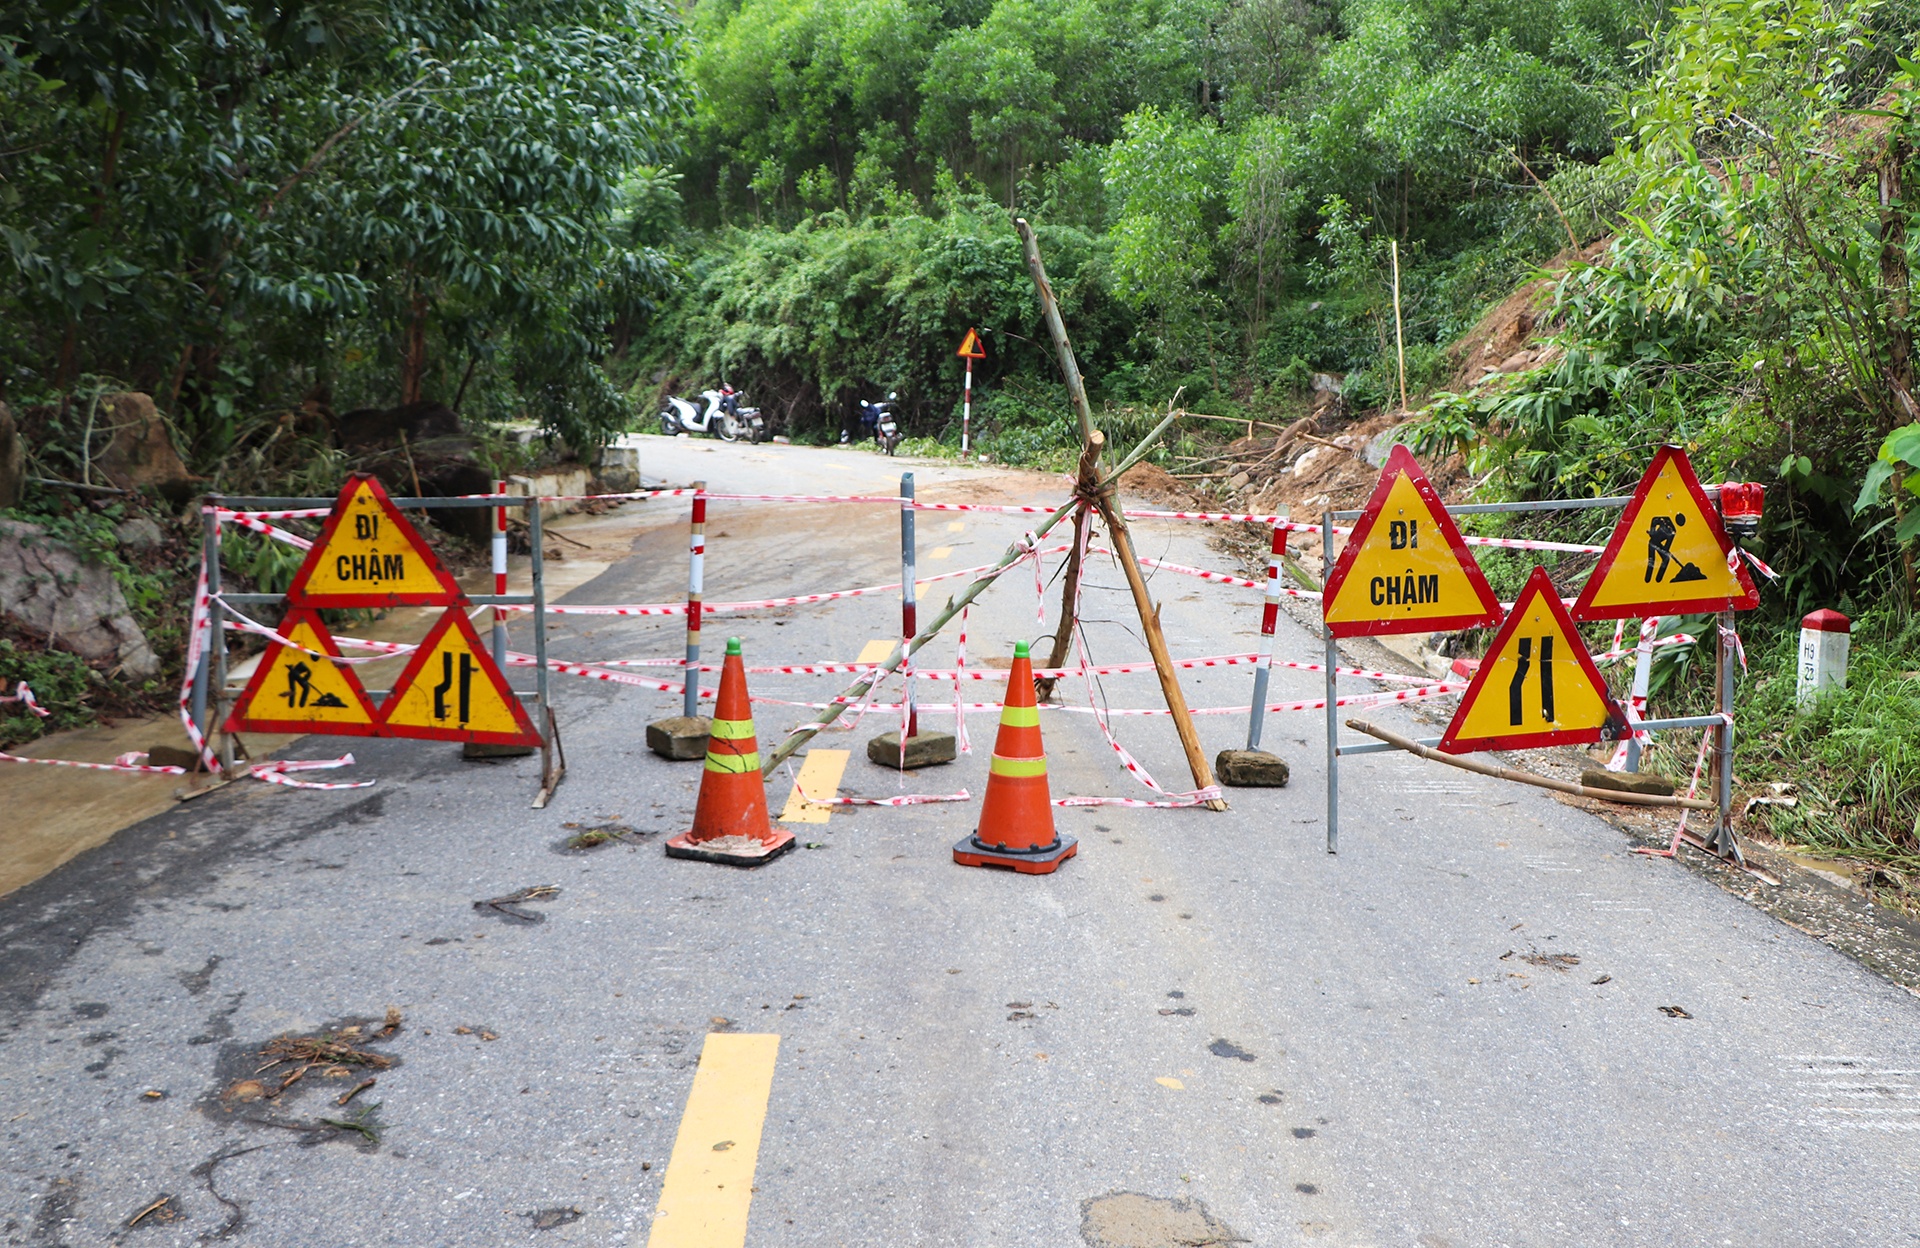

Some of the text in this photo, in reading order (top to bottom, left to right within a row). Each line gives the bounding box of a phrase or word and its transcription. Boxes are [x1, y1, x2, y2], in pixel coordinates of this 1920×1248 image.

[356, 514, 378, 540] ĐI
[1389, 520, 1418, 550] ĐI
[337, 548, 404, 585] CHẬM
[1370, 568, 1439, 611] CHẬM
